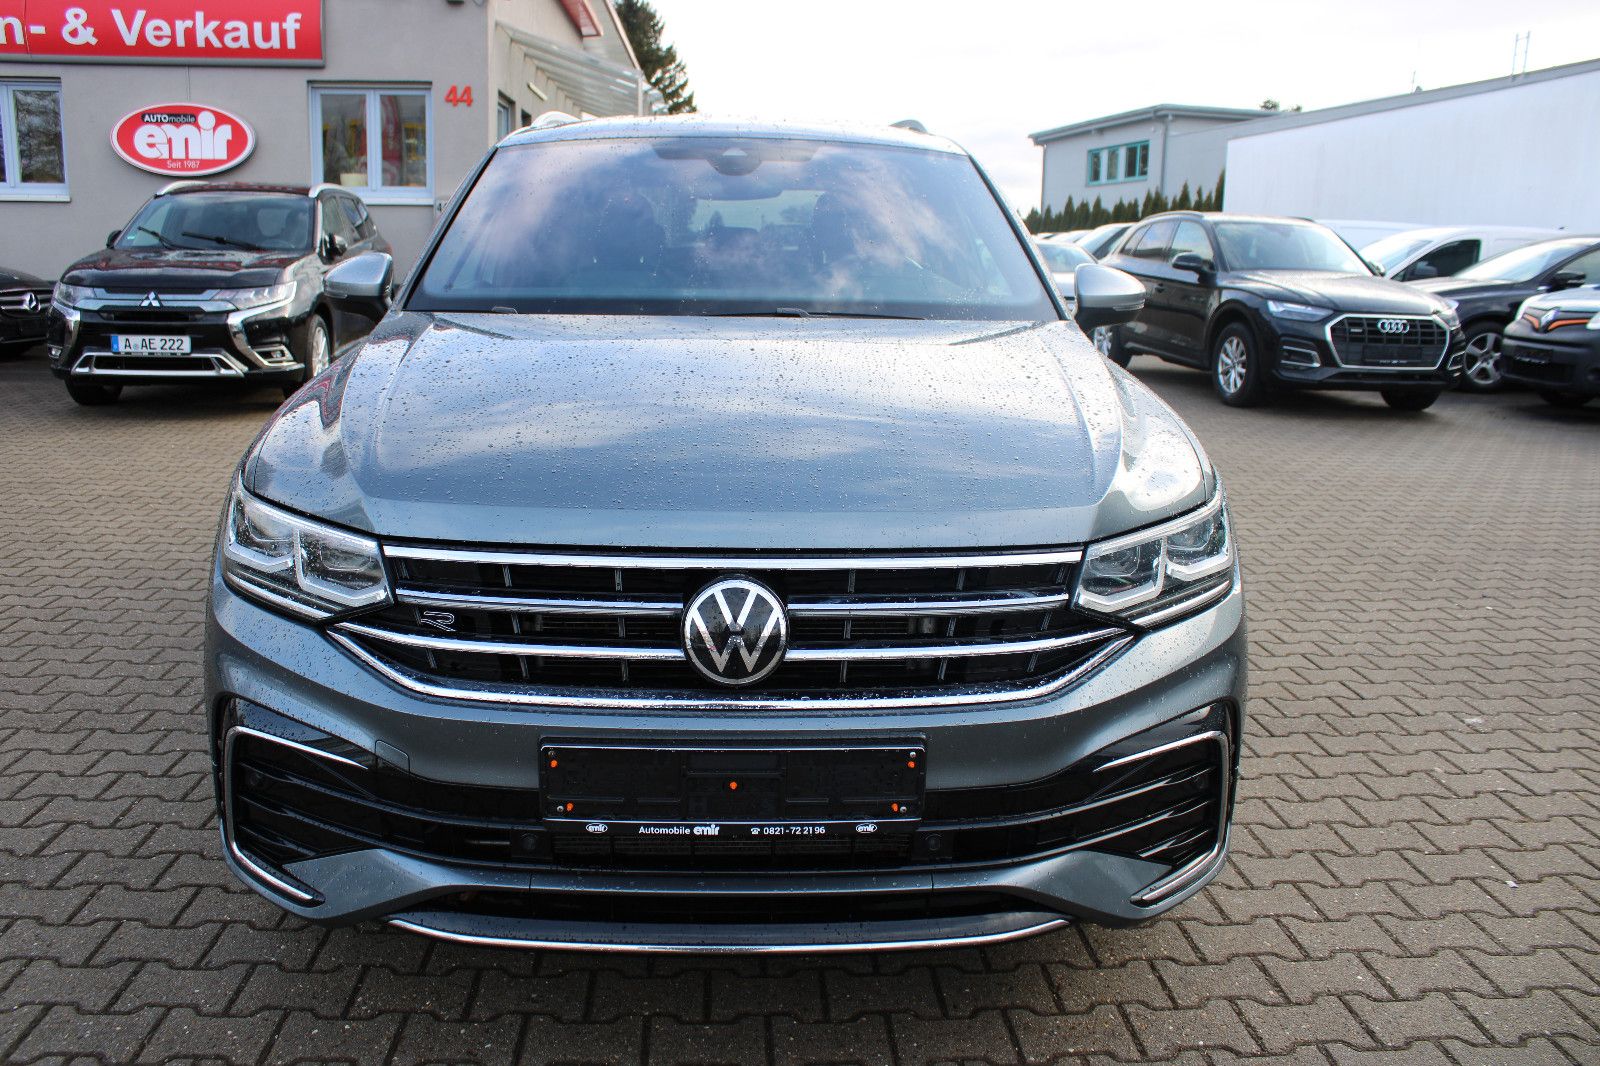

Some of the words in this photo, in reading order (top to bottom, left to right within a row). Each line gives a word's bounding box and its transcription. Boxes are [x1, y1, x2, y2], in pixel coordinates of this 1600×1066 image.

[61, 7, 98, 45] &
[111, 9, 302, 50] Verkauf
[444, 84, 474, 107] 44
[143, 114, 196, 123] AUTOmobile
[133, 110, 232, 160] emir
[166, 160, 182, 169] Seit
[183, 160, 201, 169] 1987
[124, 338, 132, 350] A
[140, 338, 157, 350] AE
[159, 338, 184, 351] 222
[638, 825, 691, 835] Automobile
[693, 823, 720, 836] emir
